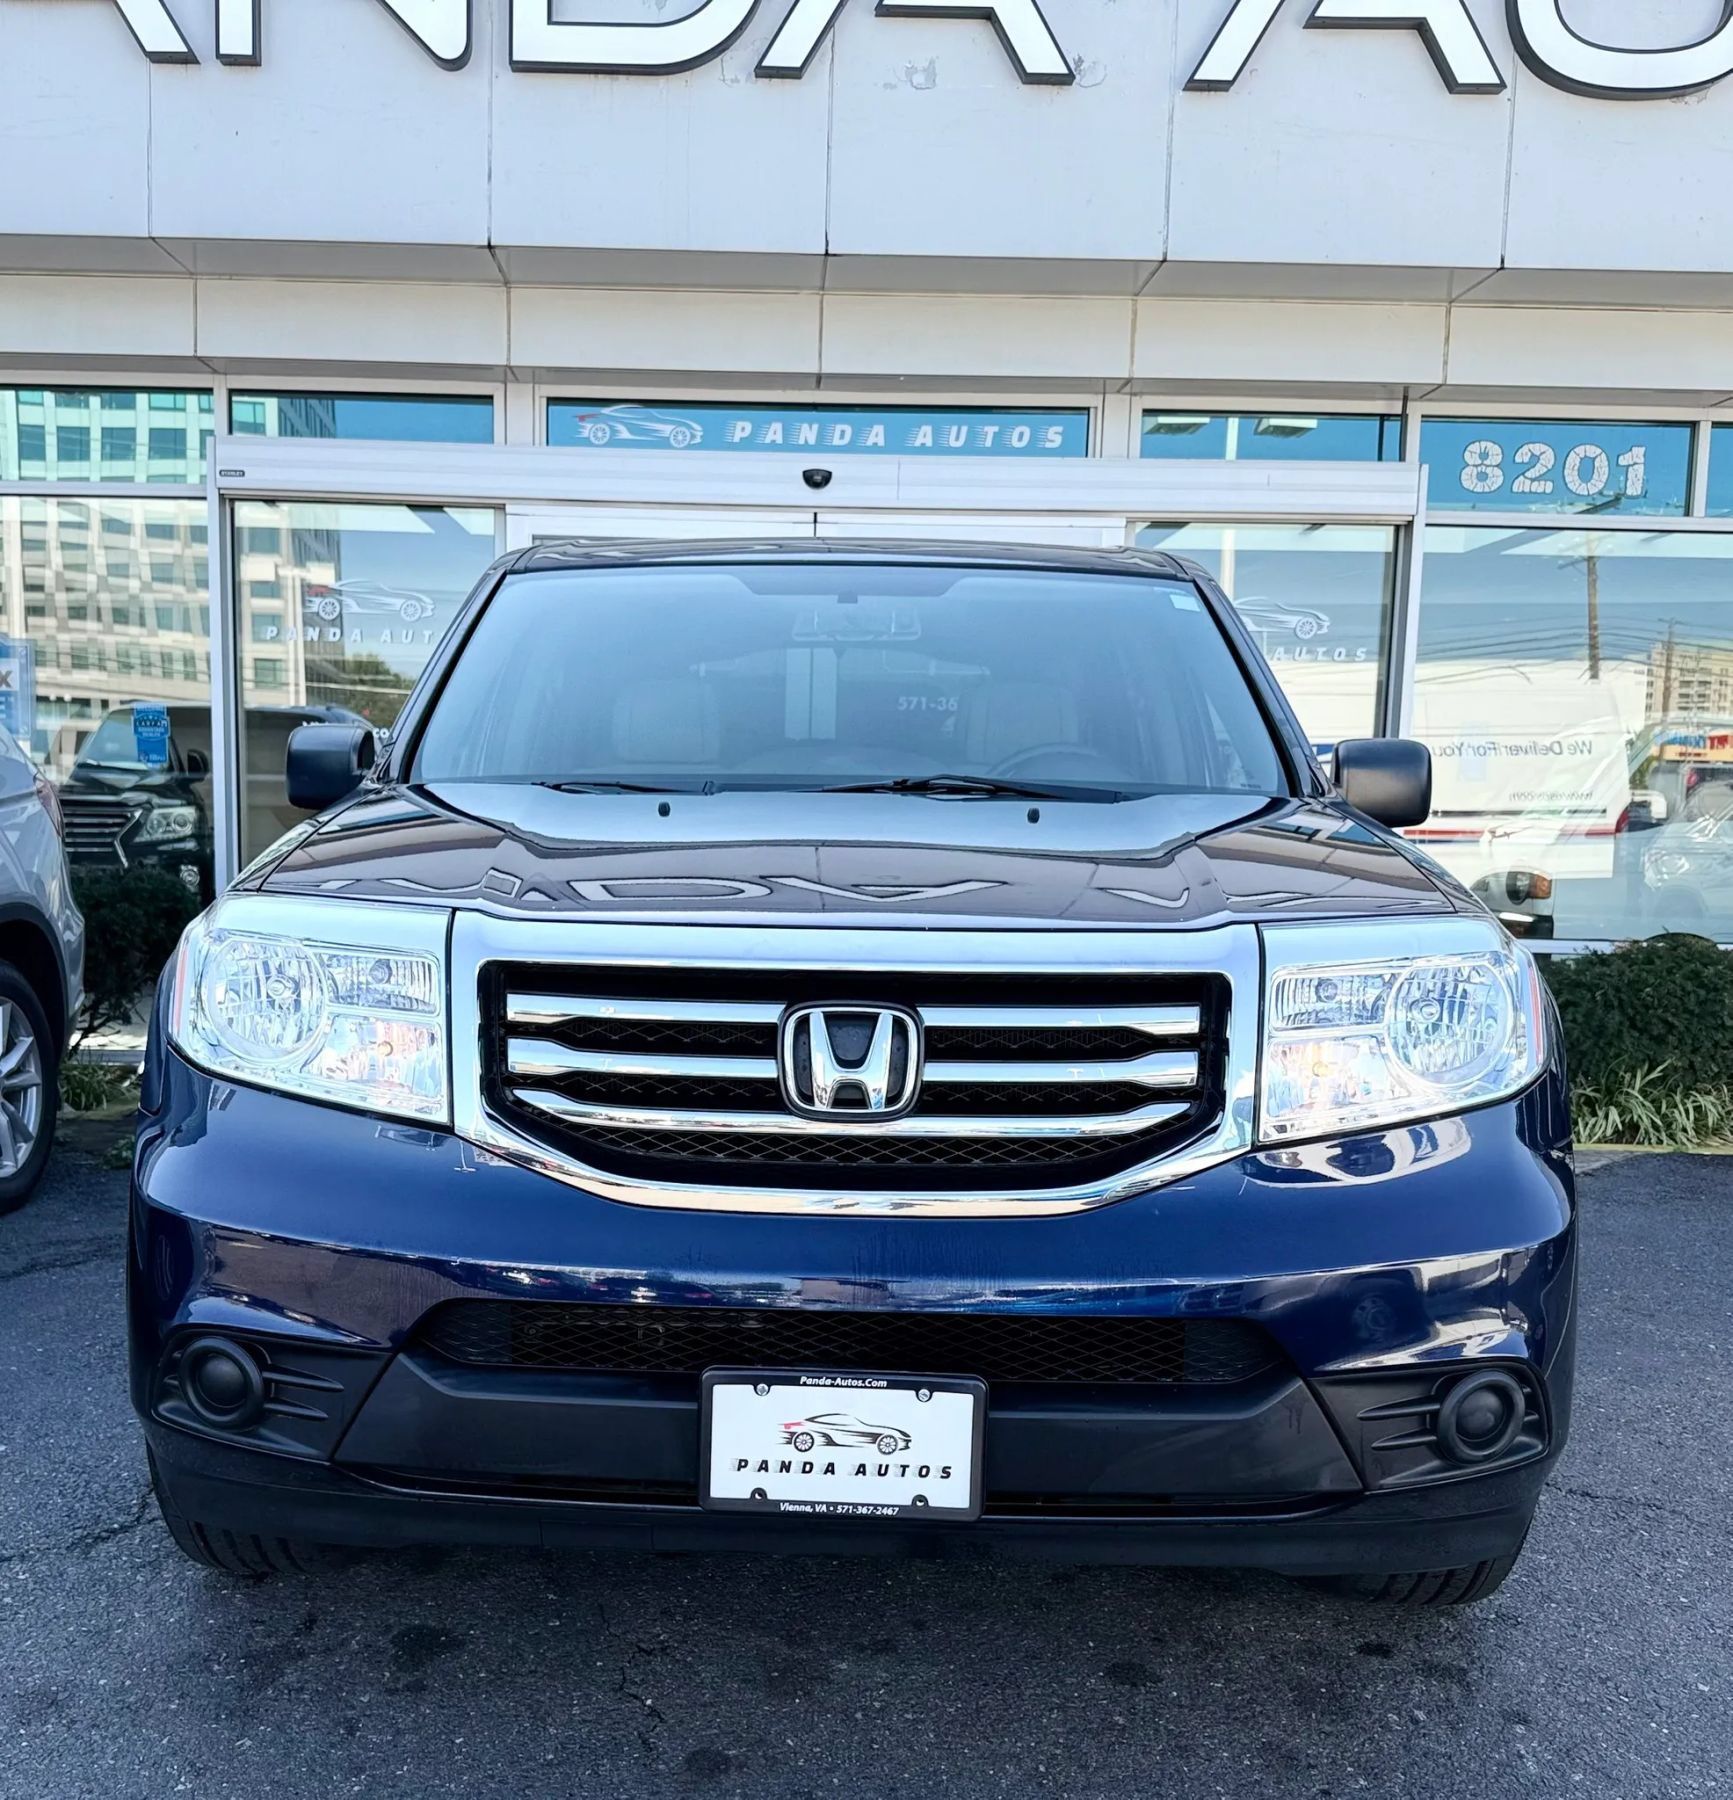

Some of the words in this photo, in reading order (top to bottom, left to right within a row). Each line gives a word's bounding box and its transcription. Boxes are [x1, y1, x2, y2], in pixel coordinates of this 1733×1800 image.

[732, 420, 885, 447] PANDA
[912, 424, 1064, 448] AUTOS
[1459, 439, 1647, 498] 8201
[266, 626, 364, 643] PANDA
[380, 627, 441, 644] AUT
[1272, 646, 1368, 661] AUTOS
[800, 1376, 887, 1388] Panda-Autos.Com
[734, 1458, 836, 1476] PANDA
[854, 1462, 952, 1480] AUTOS
[780, 1502, 813, 1514] Vienna,
[815, 1504, 827, 1513] VA
[836, 1504, 899, 1516] 571-367-2467
